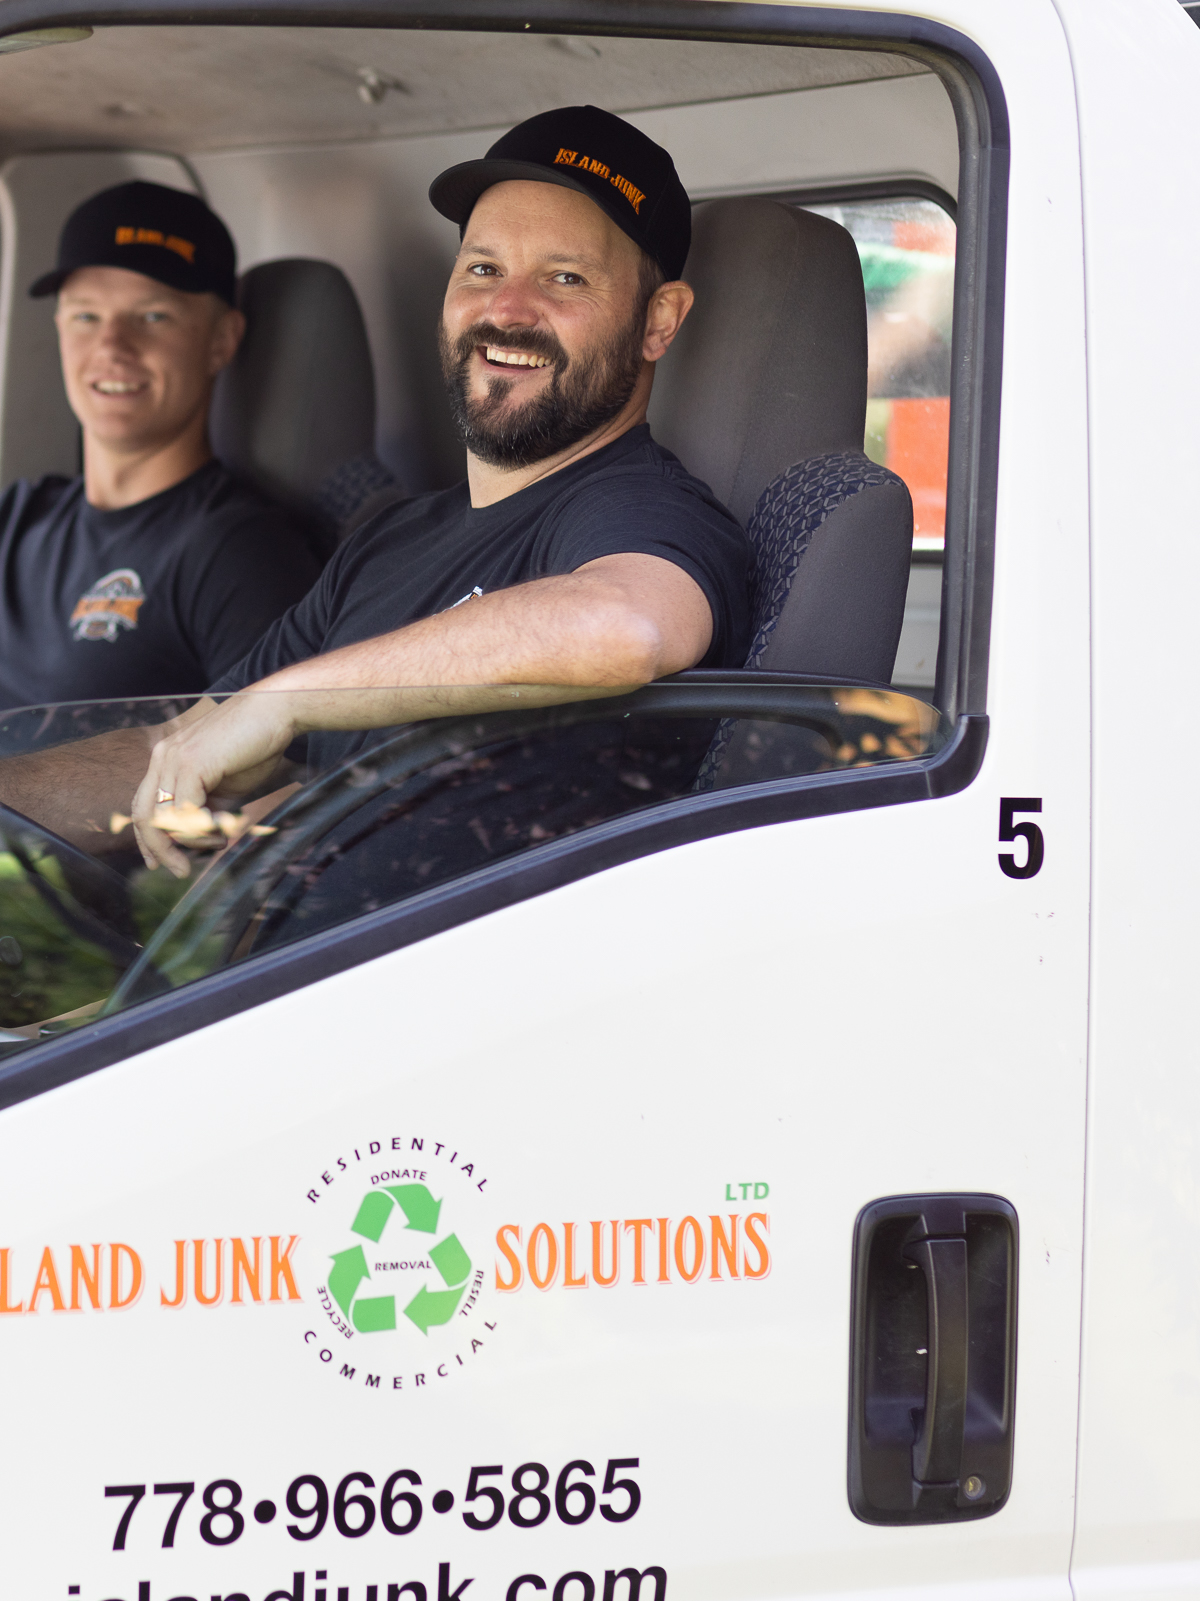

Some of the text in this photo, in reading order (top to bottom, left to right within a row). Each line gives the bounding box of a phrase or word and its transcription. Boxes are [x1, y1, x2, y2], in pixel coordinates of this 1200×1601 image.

[553, 147, 647, 216] ISLAND JUNK
[998, 797, 1044, 880] 5
[306, 1137, 488, 1203] RESIDENTIAL
[370, 1168, 428, 1185] DONATE
[725, 1182, 770, 1202] LTD
[159, 1234, 304, 1308] JUNK
[494, 1212, 772, 1294] SOLUTIONS
[374, 1260, 433, 1272] REMOVAL
[316, 1285, 355, 1340] RECYCLE
[458, 1269, 485, 1318] RESELL
[303, 1319, 498, 1390] COMMERCIAL
